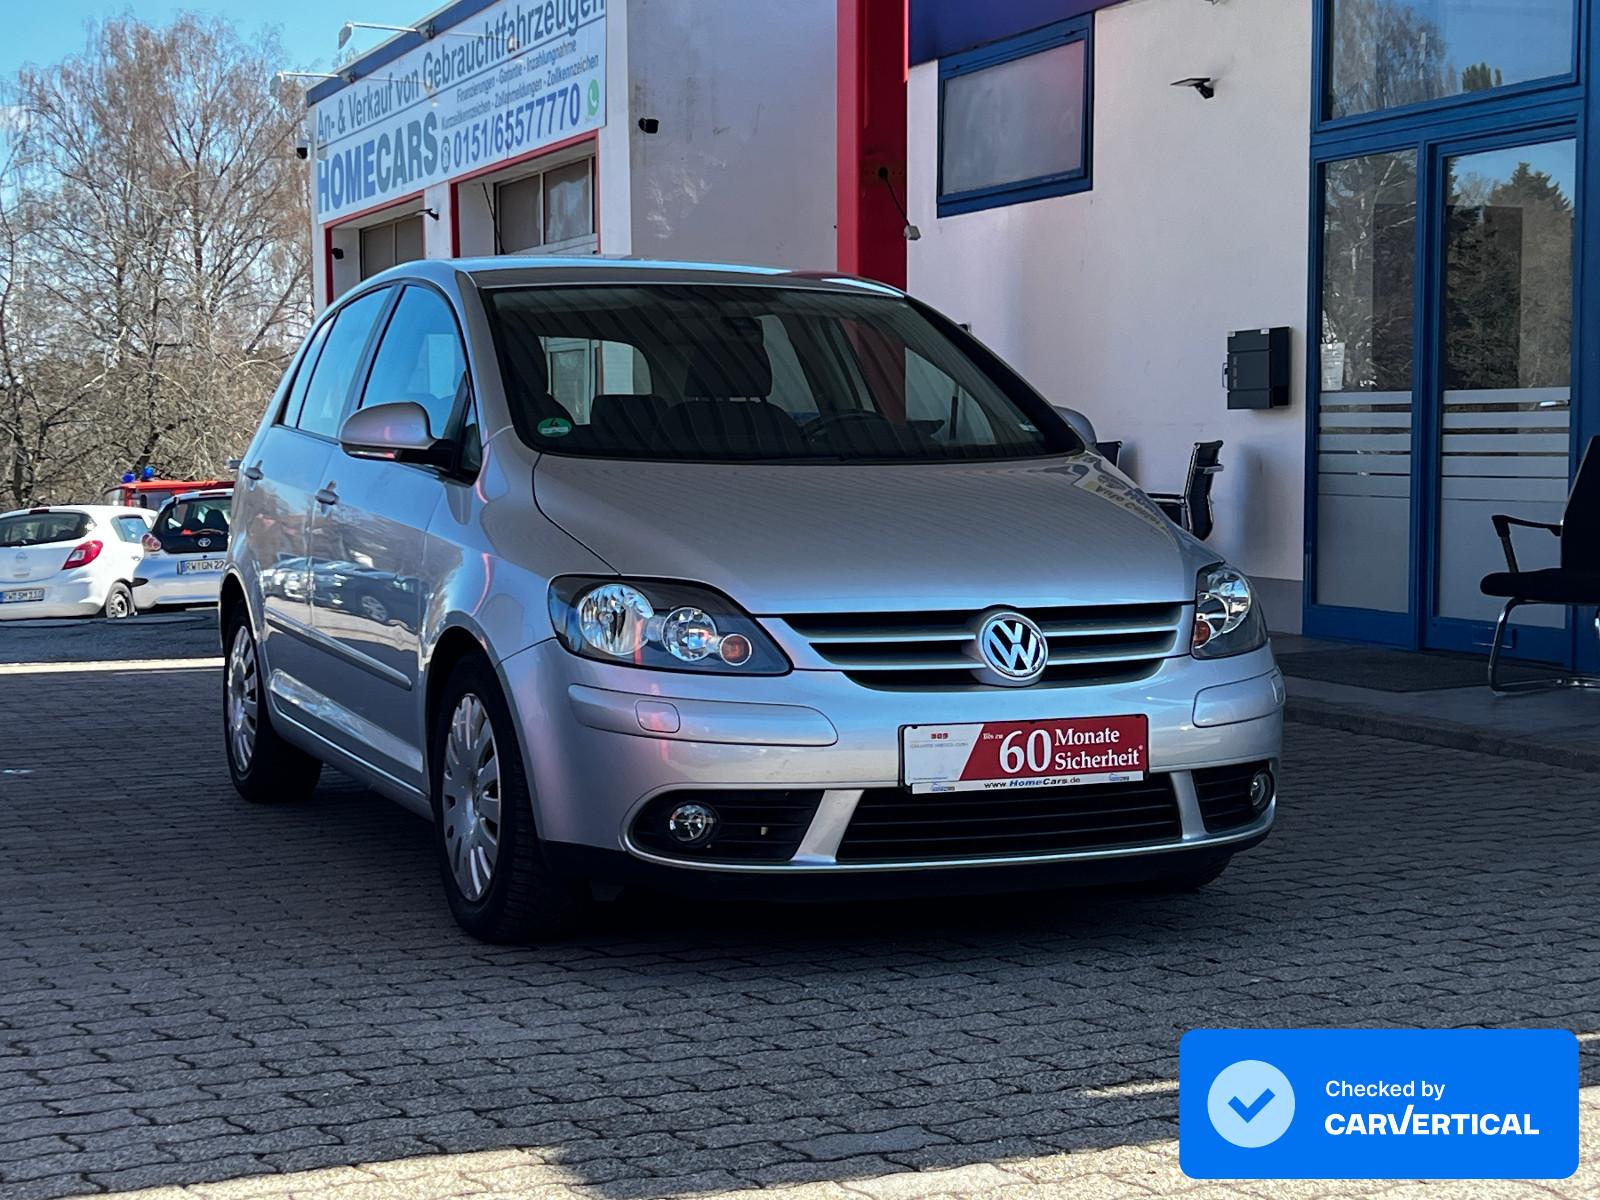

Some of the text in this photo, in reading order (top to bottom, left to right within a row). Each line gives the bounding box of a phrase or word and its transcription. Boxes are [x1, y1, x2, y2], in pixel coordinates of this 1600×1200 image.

[547, 55, 599, 87] Zollkennzeichen
[317, 109, 335, 145] An-
[338, 98, 346, 134] &
[348, 72, 392, 129] Verkauf
[395, 69, 419, 106] von
[453, 82, 581, 168] 0151/65577770
[317, 111, 438, 215] HOMECARS
[982, 617, 1043, 675] VW
[999, 729, 1052, 773] 60
[1055, 727, 1120, 746] Monate
